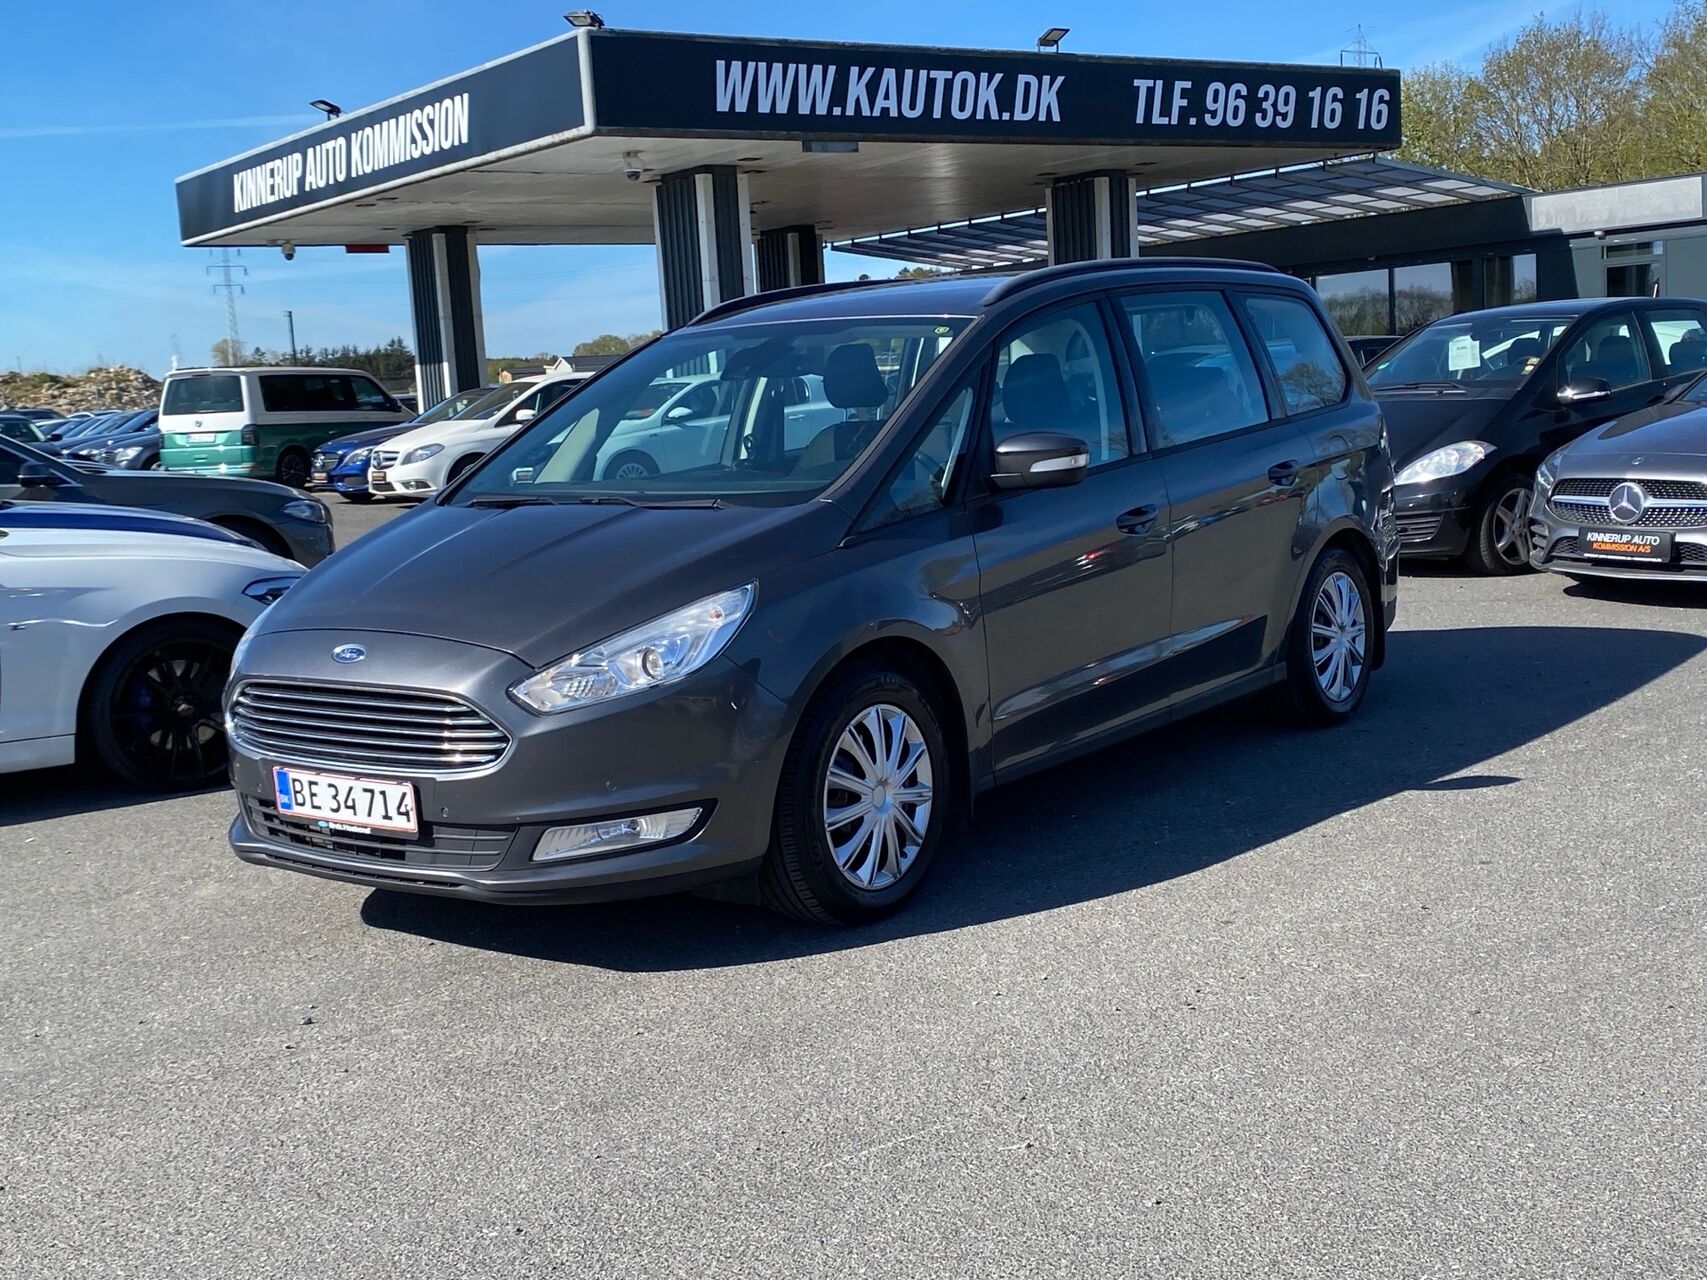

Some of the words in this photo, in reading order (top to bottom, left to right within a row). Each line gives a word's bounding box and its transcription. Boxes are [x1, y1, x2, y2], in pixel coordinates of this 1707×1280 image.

[716, 60, 1065, 122] WWW.KAUTOK.DK
[1133, 79, 1197, 125] TLF.
[1204, 82, 1248, 127] 96
[1255, 84, 1296, 128] 39
[1308, 86, 1344, 129] 16
[1355, 88, 1390, 131] 16
[233, 152, 303, 213] KINNERUP
[305, 137, 346, 191] AUTO
[351, 93, 469, 177] KOMMISSION
[1586, 531, 1631, 543] KINNERUP
[1632, 534, 1660, 545] AUTO
[1592, 542, 1637, 552] KOMMISSION
